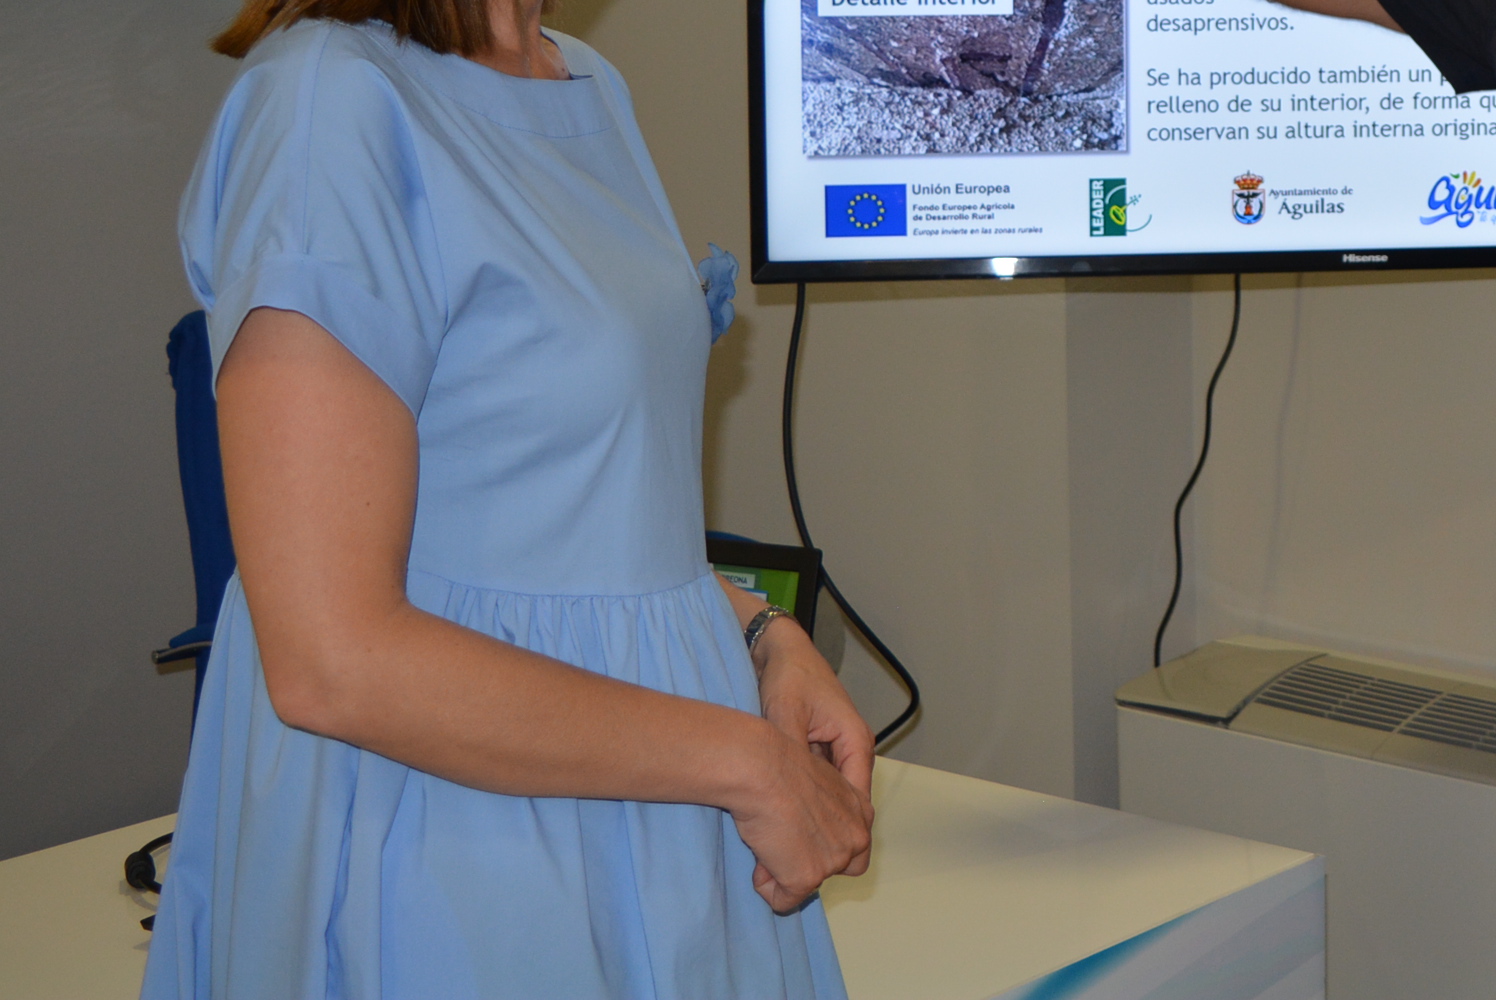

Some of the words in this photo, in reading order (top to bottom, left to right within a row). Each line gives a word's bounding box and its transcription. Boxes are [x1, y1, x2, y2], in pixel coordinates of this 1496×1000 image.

[1146, 12, 1295, 37] desaprensivos.
[1146, 67, 1171, 87] Se
[1177, 67, 1202, 86] ha
[1209, 66, 1312, 91] producido
[1317, 64, 1401, 85] también
[1408, 68, 1432, 83] un
[1147, 95, 1220, 114] relleno
[1226, 94, 1253, 113] de
[1260, 98, 1282, 113] su
[1290, 92, 1370, 115] interior,
[1379, 92, 1405, 111] de
[1412, 91, 1472, 110] forma
[1146, 125, 1250, 142] conservan
[1256, 125, 1278, 140] su
[1284, 120, 1346, 140] altura
[1352, 119, 1425, 139] interna
[911, 183, 952, 195] Unión
[955, 182, 1011, 196] Europea
[1268, 186, 1339, 201] Ayuntamiento
[1340, 185, 1354, 196] de
[912, 203, 940, 212] Fondo
[942, 203, 978, 212] Europeo
[912, 213, 923, 221] de
[971, 212, 995, 220] Rural
[1091, 179, 1105, 235] LEADER
[1277, 197, 1345, 221] Águilas
[1342, 253, 1389, 263] Hisense
